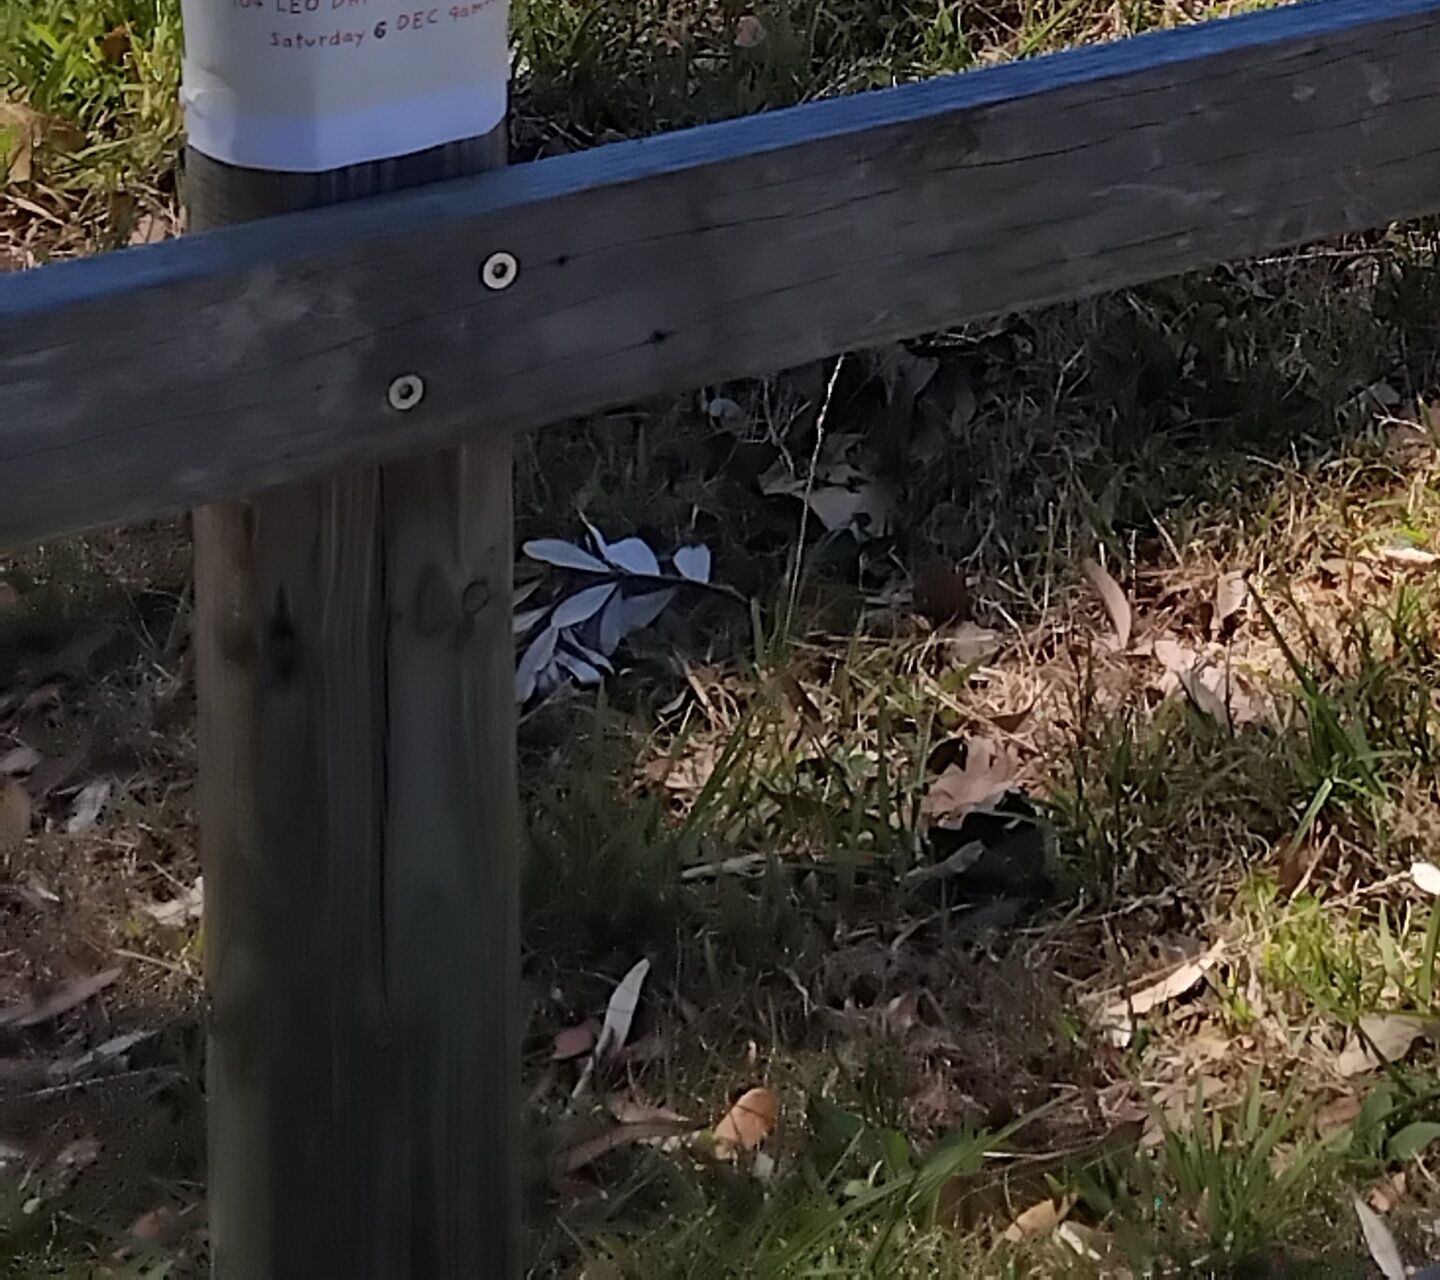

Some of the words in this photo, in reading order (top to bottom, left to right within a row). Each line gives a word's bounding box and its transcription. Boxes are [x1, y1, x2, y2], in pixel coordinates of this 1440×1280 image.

[269, 27, 366, 49] Saturday
[372, 20, 388, 40] 6
[396, 8, 440, 32] DEC
